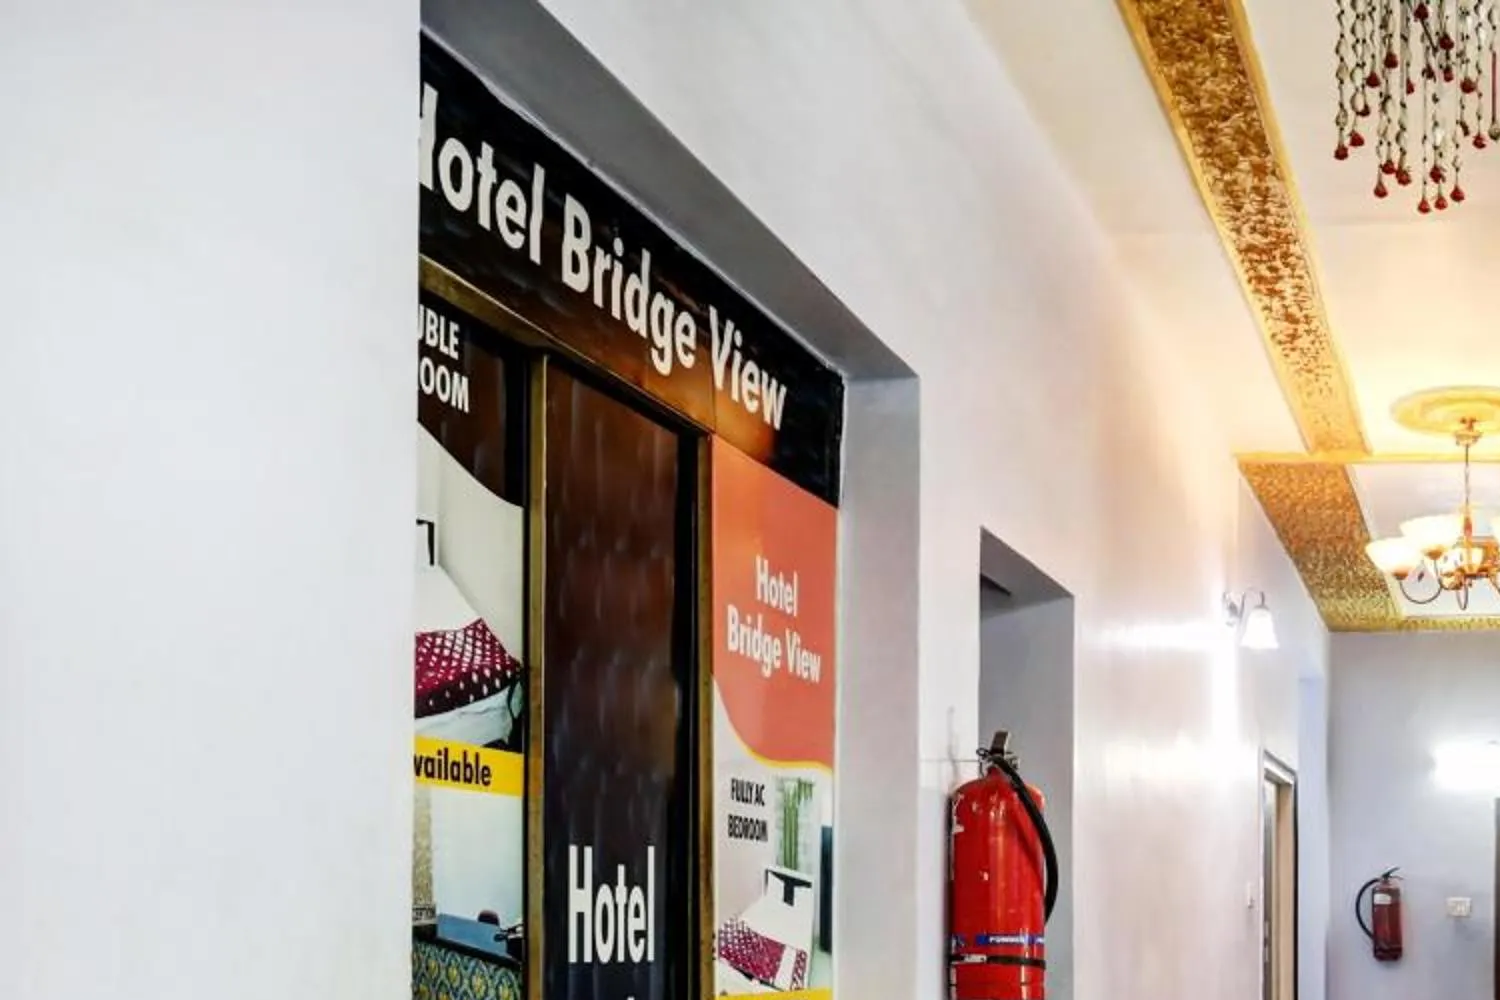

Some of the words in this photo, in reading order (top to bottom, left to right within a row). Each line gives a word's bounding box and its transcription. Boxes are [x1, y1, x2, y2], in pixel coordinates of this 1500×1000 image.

[562, 193, 697, 376] Bridge
[709, 305, 787, 431] View
[417, 356, 469, 414] OOM
[756, 555, 798, 616] Hotel
[727, 604, 781, 678] Bridge
[785, 628, 821, 684] View
[414, 747, 491, 786] vailable
[731, 778, 753, 804] FULLY
[754, 783, 765, 807] AC
[728, 814, 768, 842] BEDROOM
[568, 844, 654, 964] Hotel
